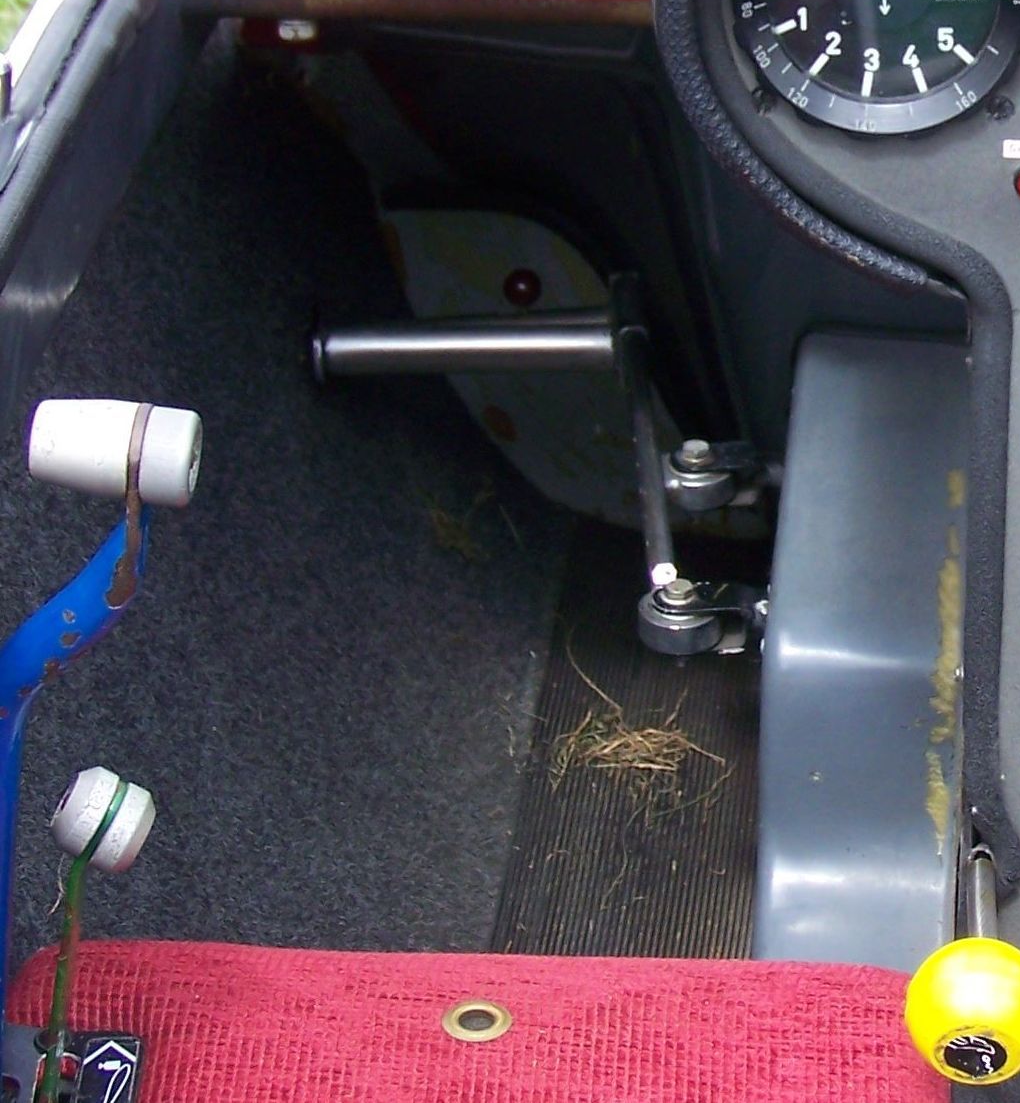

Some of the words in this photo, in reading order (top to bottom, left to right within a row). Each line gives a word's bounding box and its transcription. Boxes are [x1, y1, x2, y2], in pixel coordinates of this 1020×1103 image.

[797, 7, 807, 31] 1
[825, 31, 841, 55] 2
[937, 27, 954, 52] 5
[753, 44, 772, 69] 100
[863, 47, 880, 72] 3
[902, 44, 920, 68] 4
[786, 87, 808, 108] 120
[955, 91, 977, 111] 160
